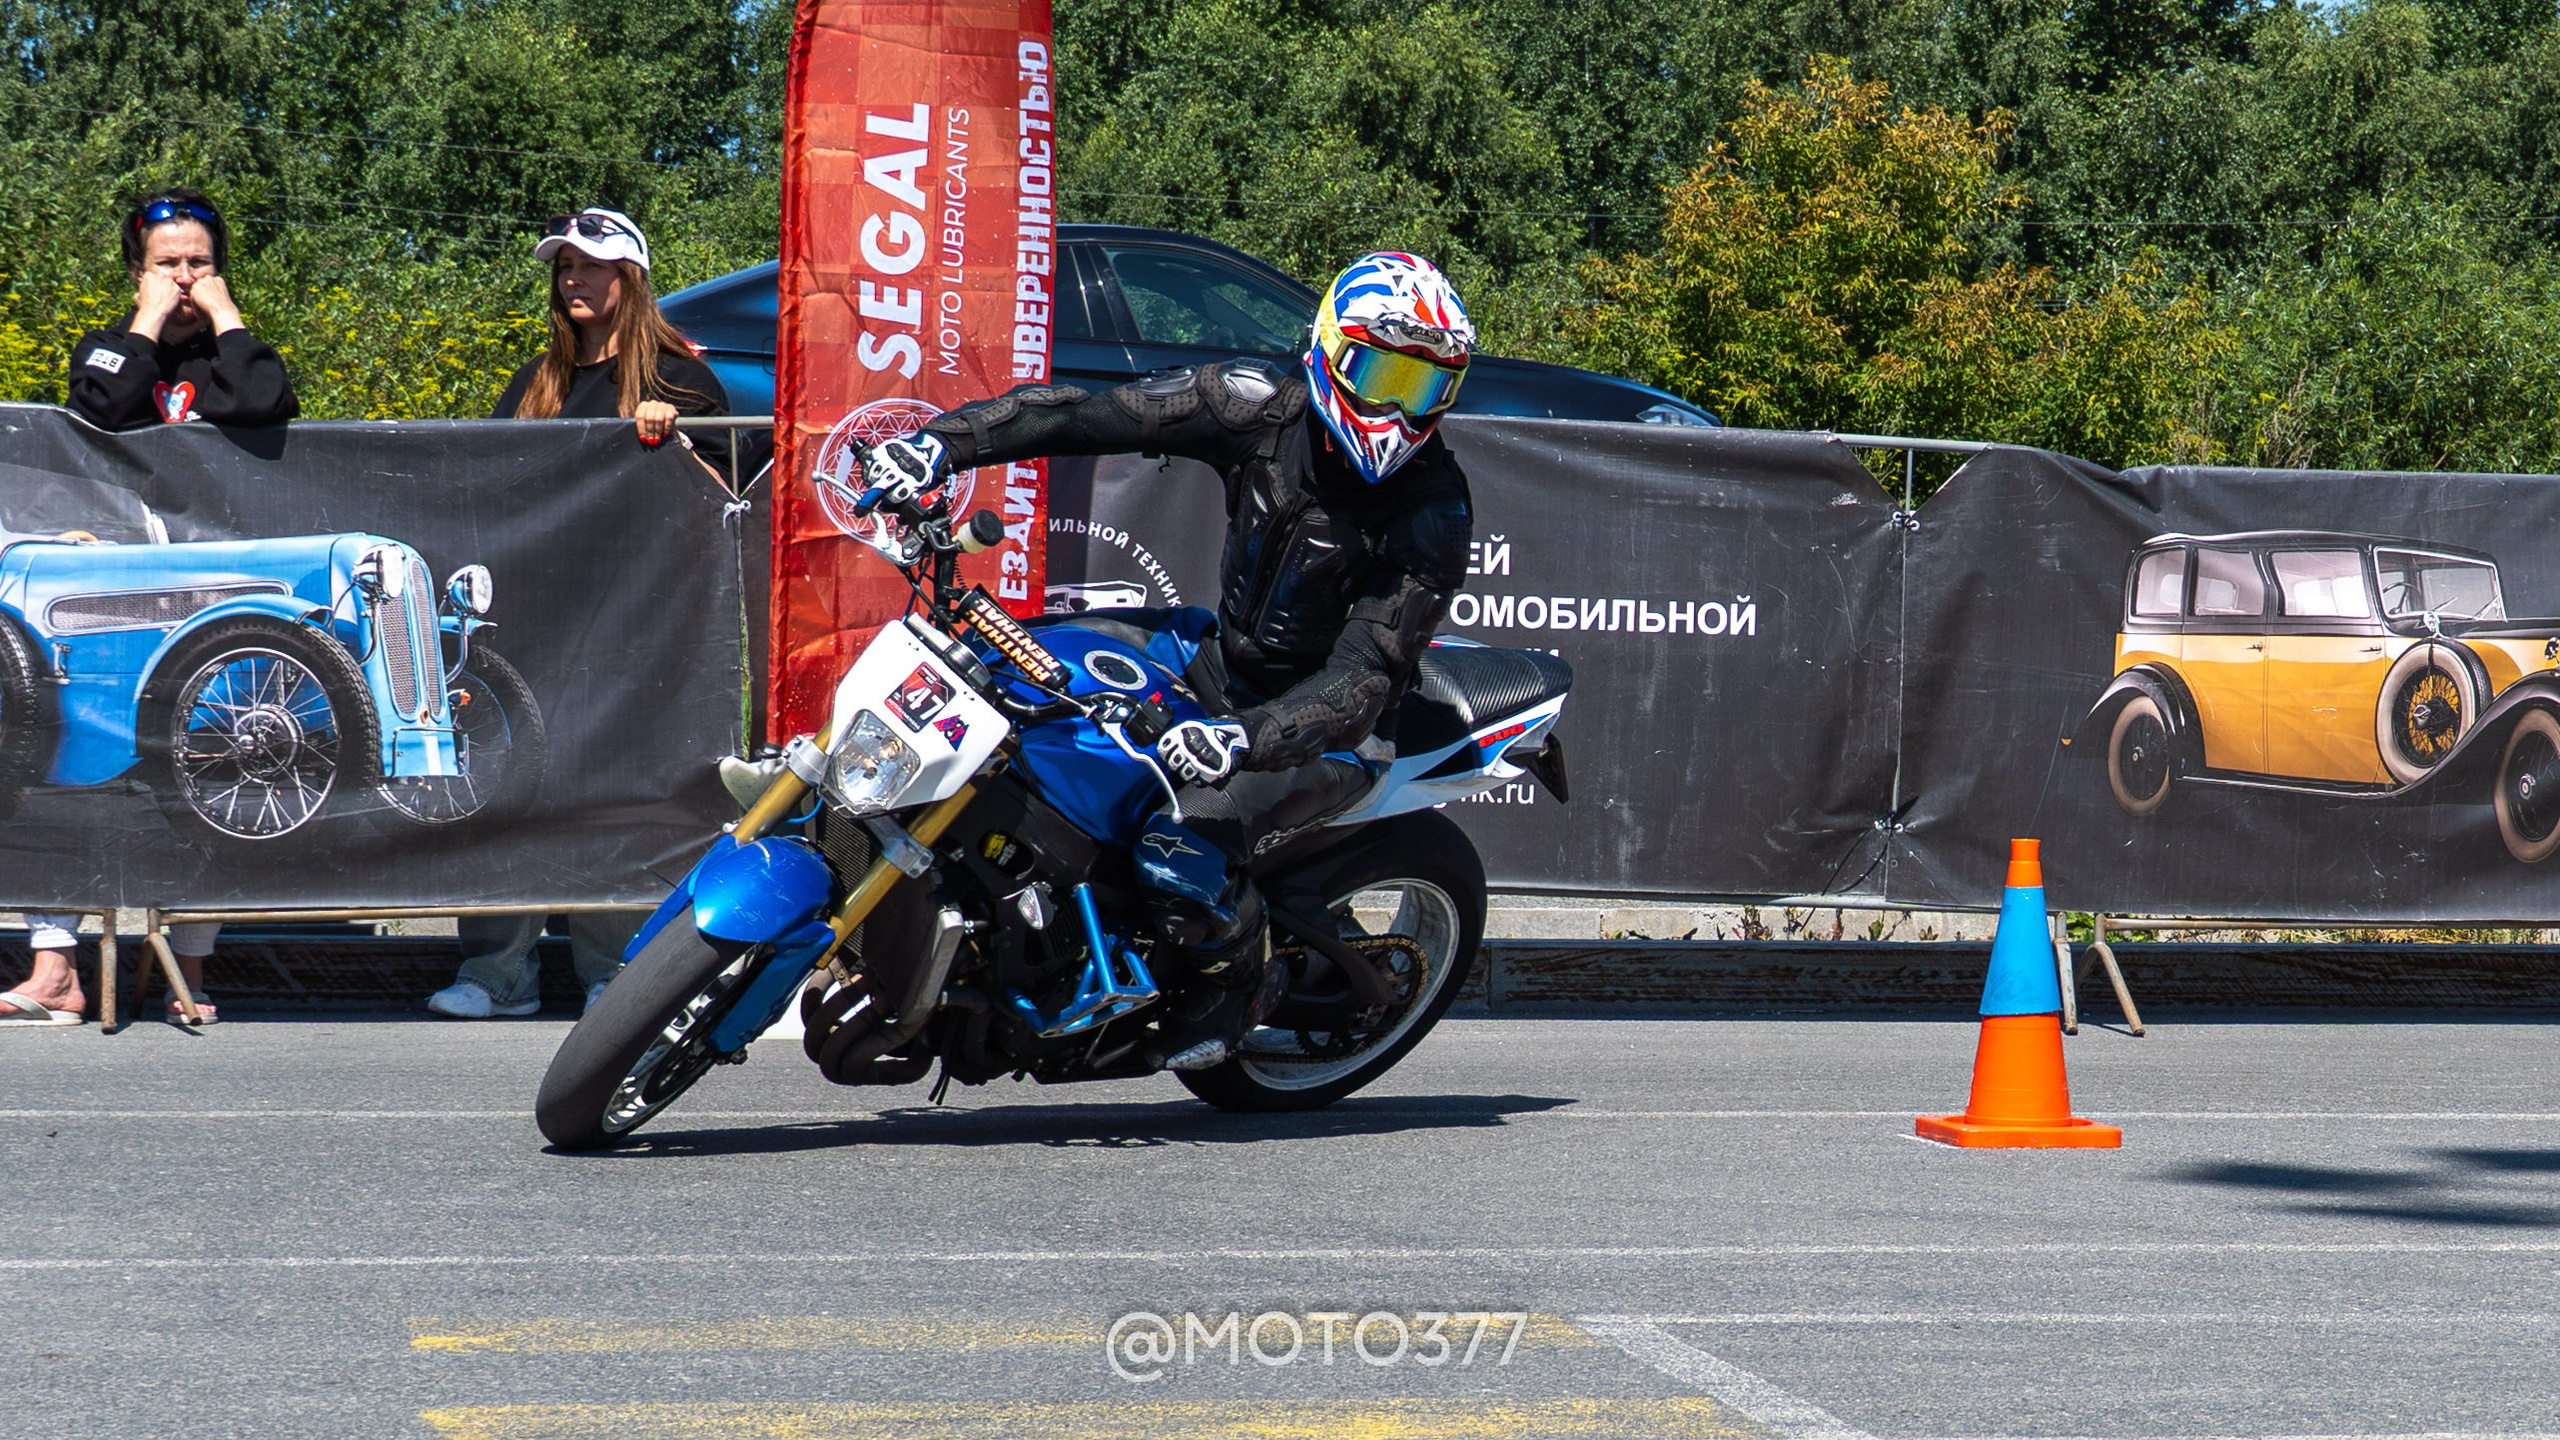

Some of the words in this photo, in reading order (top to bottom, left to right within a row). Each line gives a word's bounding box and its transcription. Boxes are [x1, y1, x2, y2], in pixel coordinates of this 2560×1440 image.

[941, 107, 970, 284] LUBRICANTS
[1012, 41, 1051, 379] УВЕРЕННОСТЬЮ
[857, 102, 930, 380] SEGAL
[938, 291, 963, 375] MOTO
[968, 609, 1052, 682] RENTHAL
[976, 598, 1061, 670] RENTHAL
[1449, 593, 1757, 636] ОМОБИЛЬНОЙ
[905, 686, 946, 720] 47
[1479, 723, 1526, 748] 600
